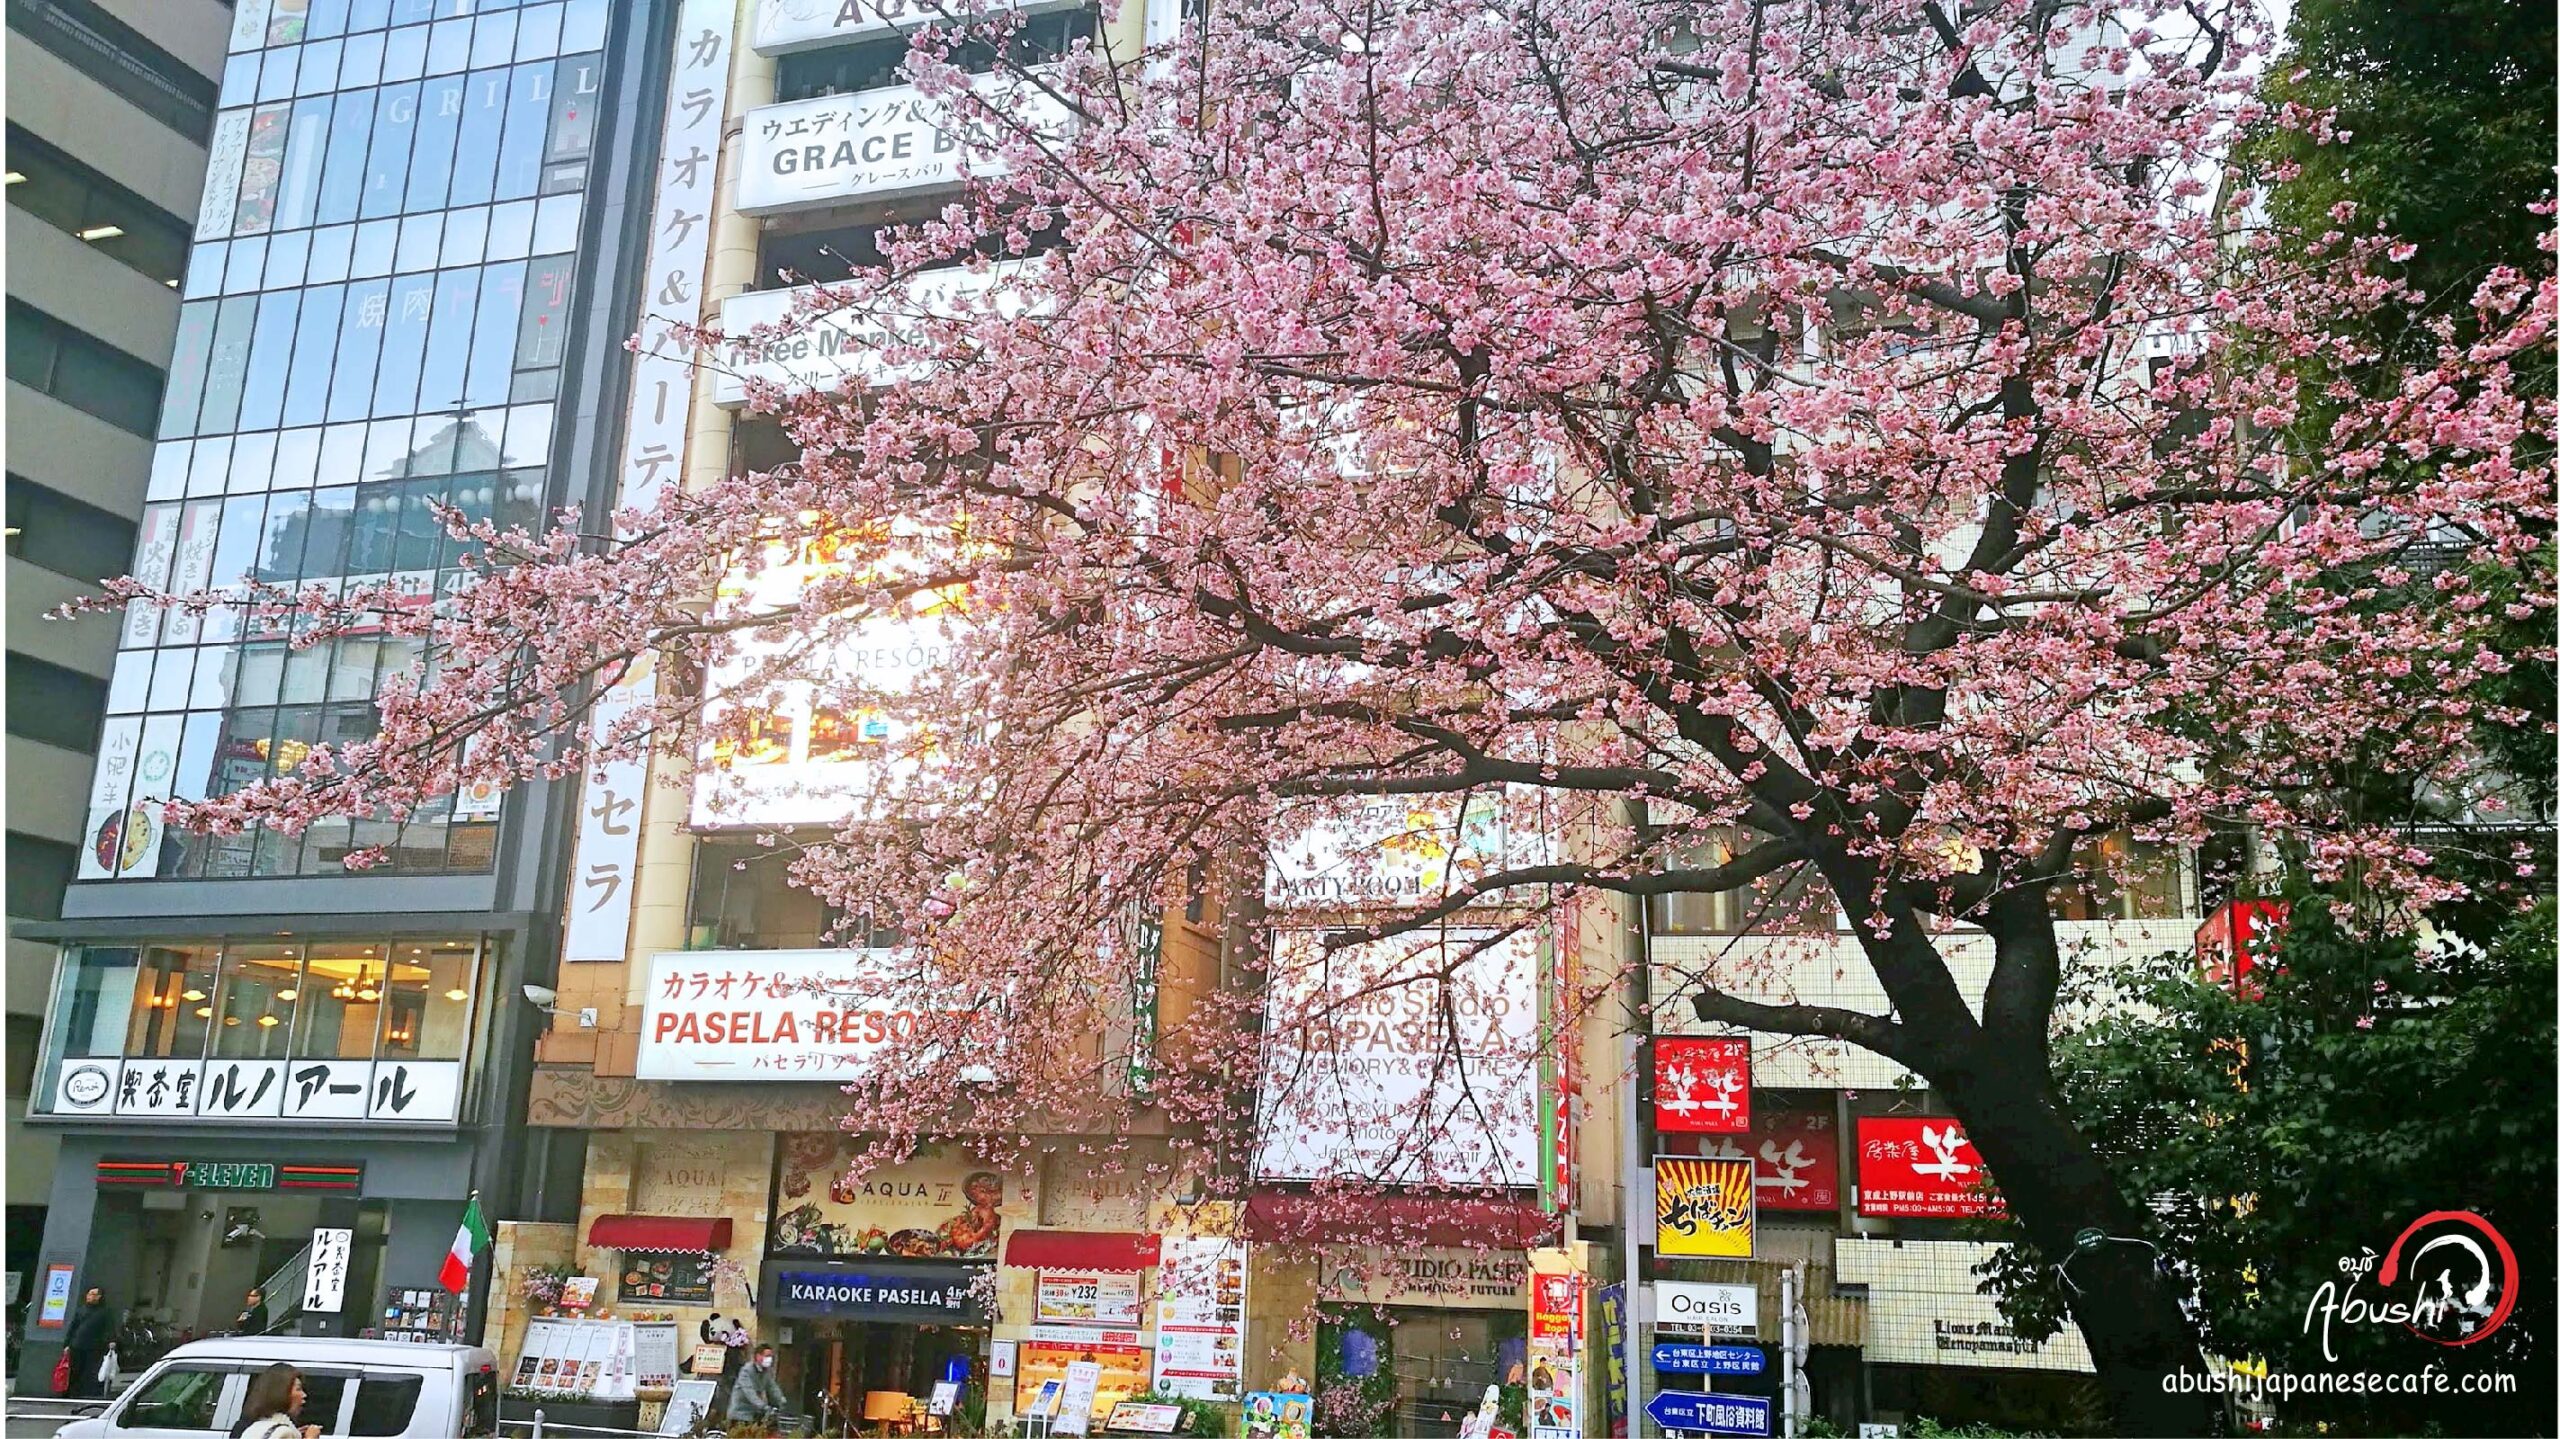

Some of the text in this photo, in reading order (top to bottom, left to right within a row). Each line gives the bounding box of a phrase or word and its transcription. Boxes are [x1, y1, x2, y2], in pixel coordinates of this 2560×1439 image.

[773, 133, 913, 175] GRACE
[851, 163, 944, 188] グレースバリ
[1403, 989, 1510, 1016] Stdio
[655, 1011, 800, 1044] PASELA
[1724, 1043, 1744, 1056] 2F
[1302, 1058, 1395, 1076] EMORY
[121, 1063, 418, 1113] 喫茶室 ルノアール
[663, 1169, 717, 1188] AQUA
[862, 1182, 928, 1198] AQUA
[307, 1230, 333, 1309] ルノアール
[791, 1284, 942, 1306] KARAOKE PASELA
[1470, 1284, 1516, 1297] FUTURE
[1671, 1294, 1743, 1315] Oasis
[1670, 1323, 1742, 1334] TEL 03-03-0354
[1934, 1320, 1975, 1336] Lions
[1672, 1349, 1760, 1360] 台東区上野地区センター
[1695, 1403, 1765, 1430] 下町風俗資料館
